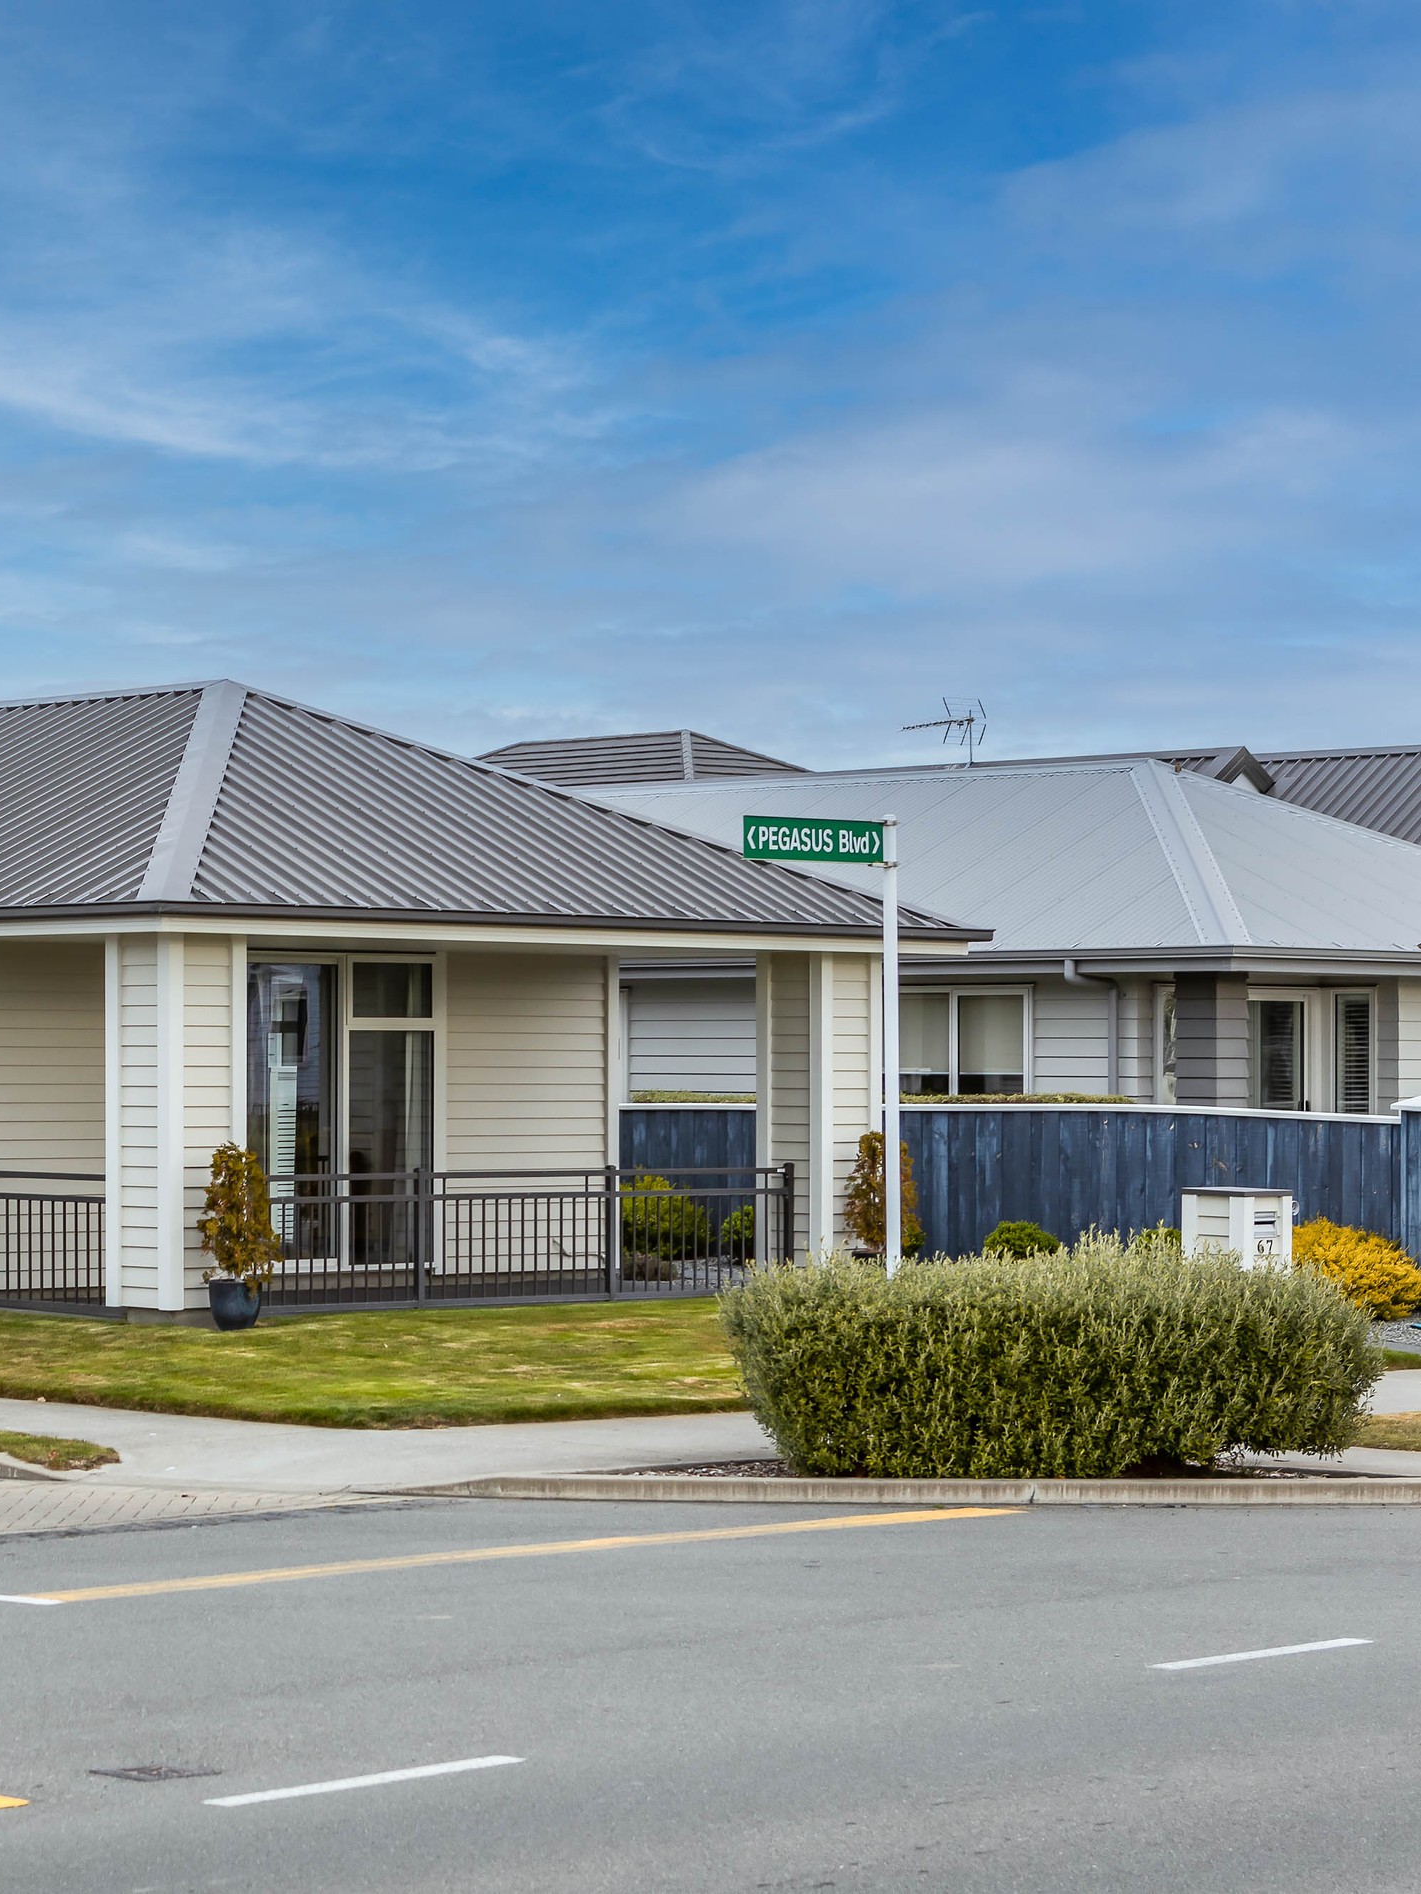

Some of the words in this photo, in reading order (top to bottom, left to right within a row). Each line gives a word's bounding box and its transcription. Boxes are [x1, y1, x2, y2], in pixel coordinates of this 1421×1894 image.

[758, 826, 834, 853] PEGASUS
[838, 829, 870, 854] Blvd
[1257, 1239, 1273, 1255] 67
